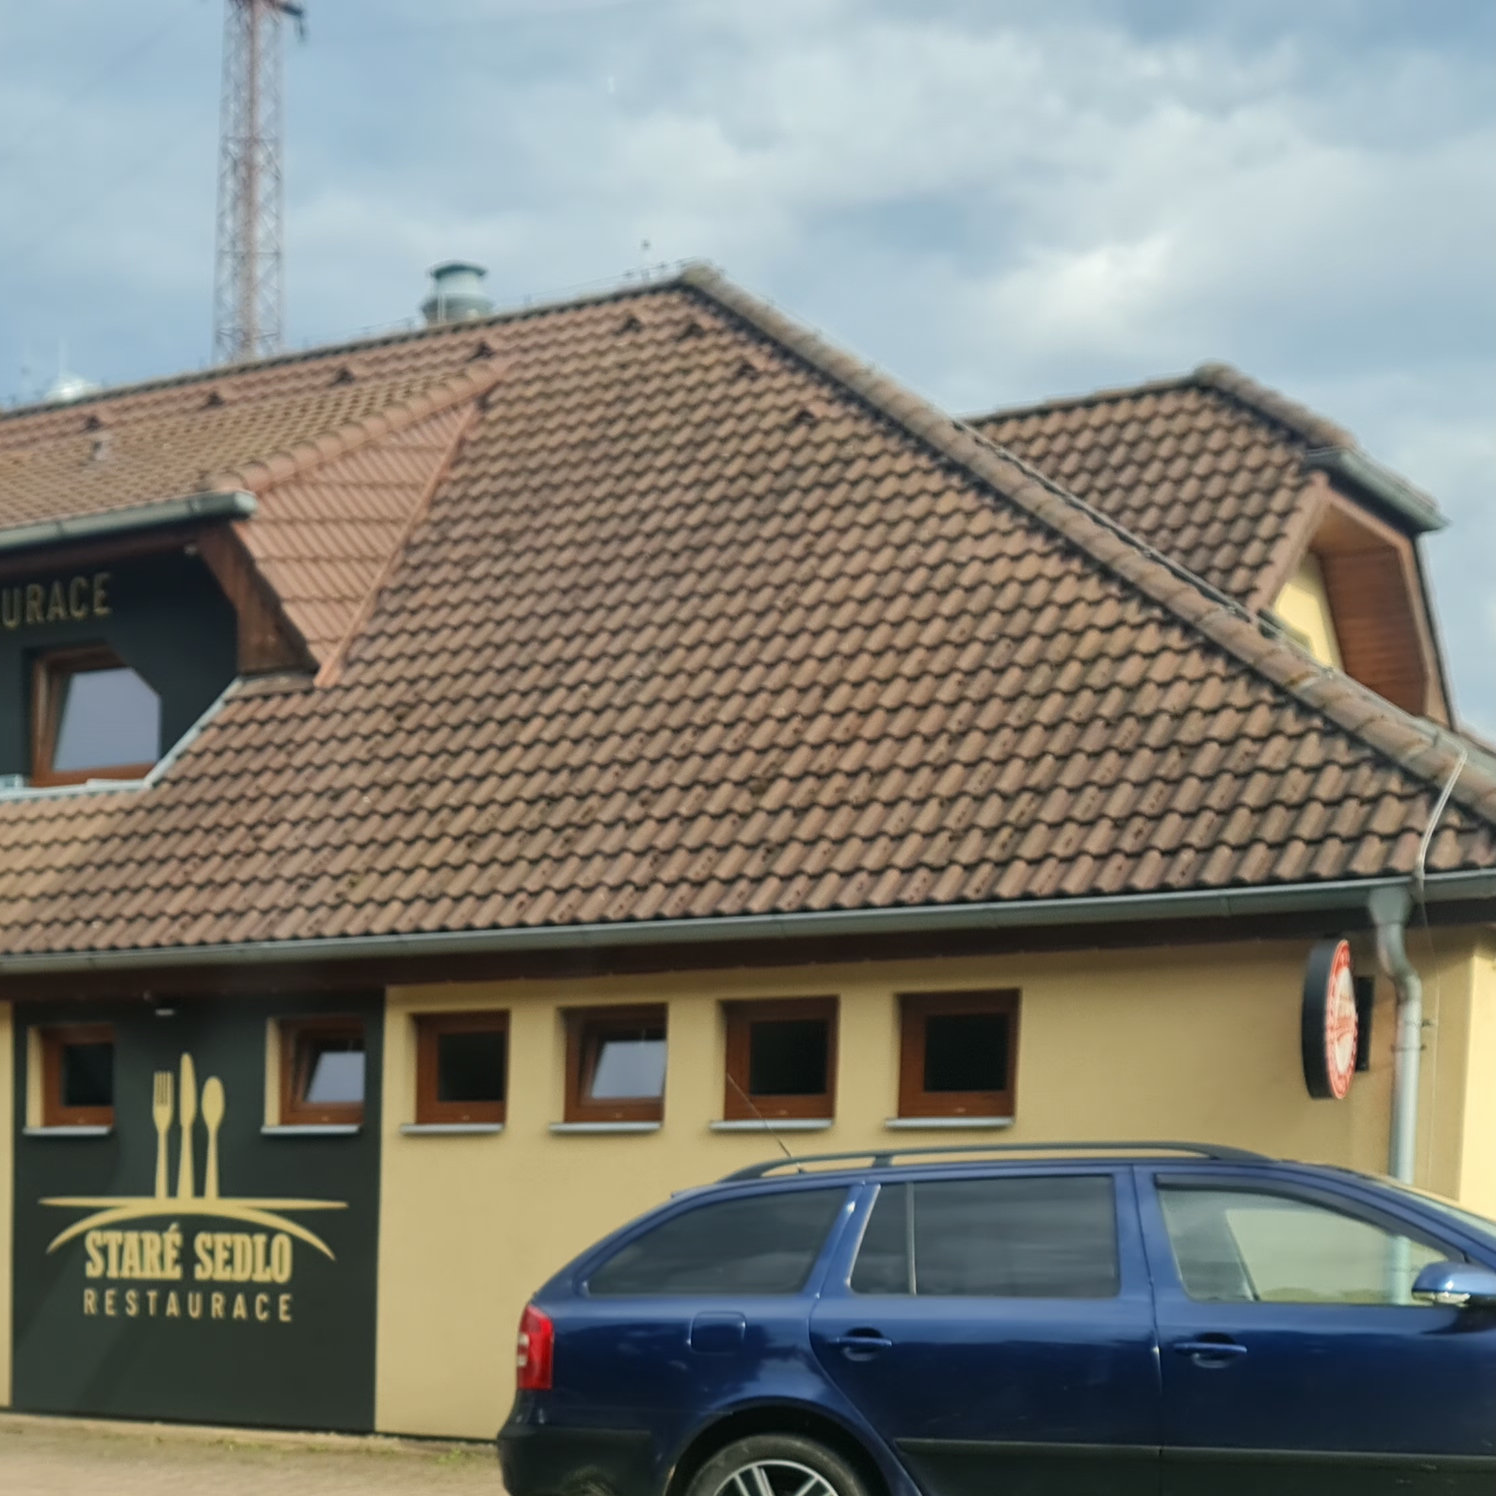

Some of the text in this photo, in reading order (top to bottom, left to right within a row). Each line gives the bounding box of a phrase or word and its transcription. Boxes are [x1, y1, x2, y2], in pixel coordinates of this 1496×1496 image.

[85, 1222, 293, 1284] STARÉ SEDLO
[83, 1287, 292, 1323] RESTAURACE
